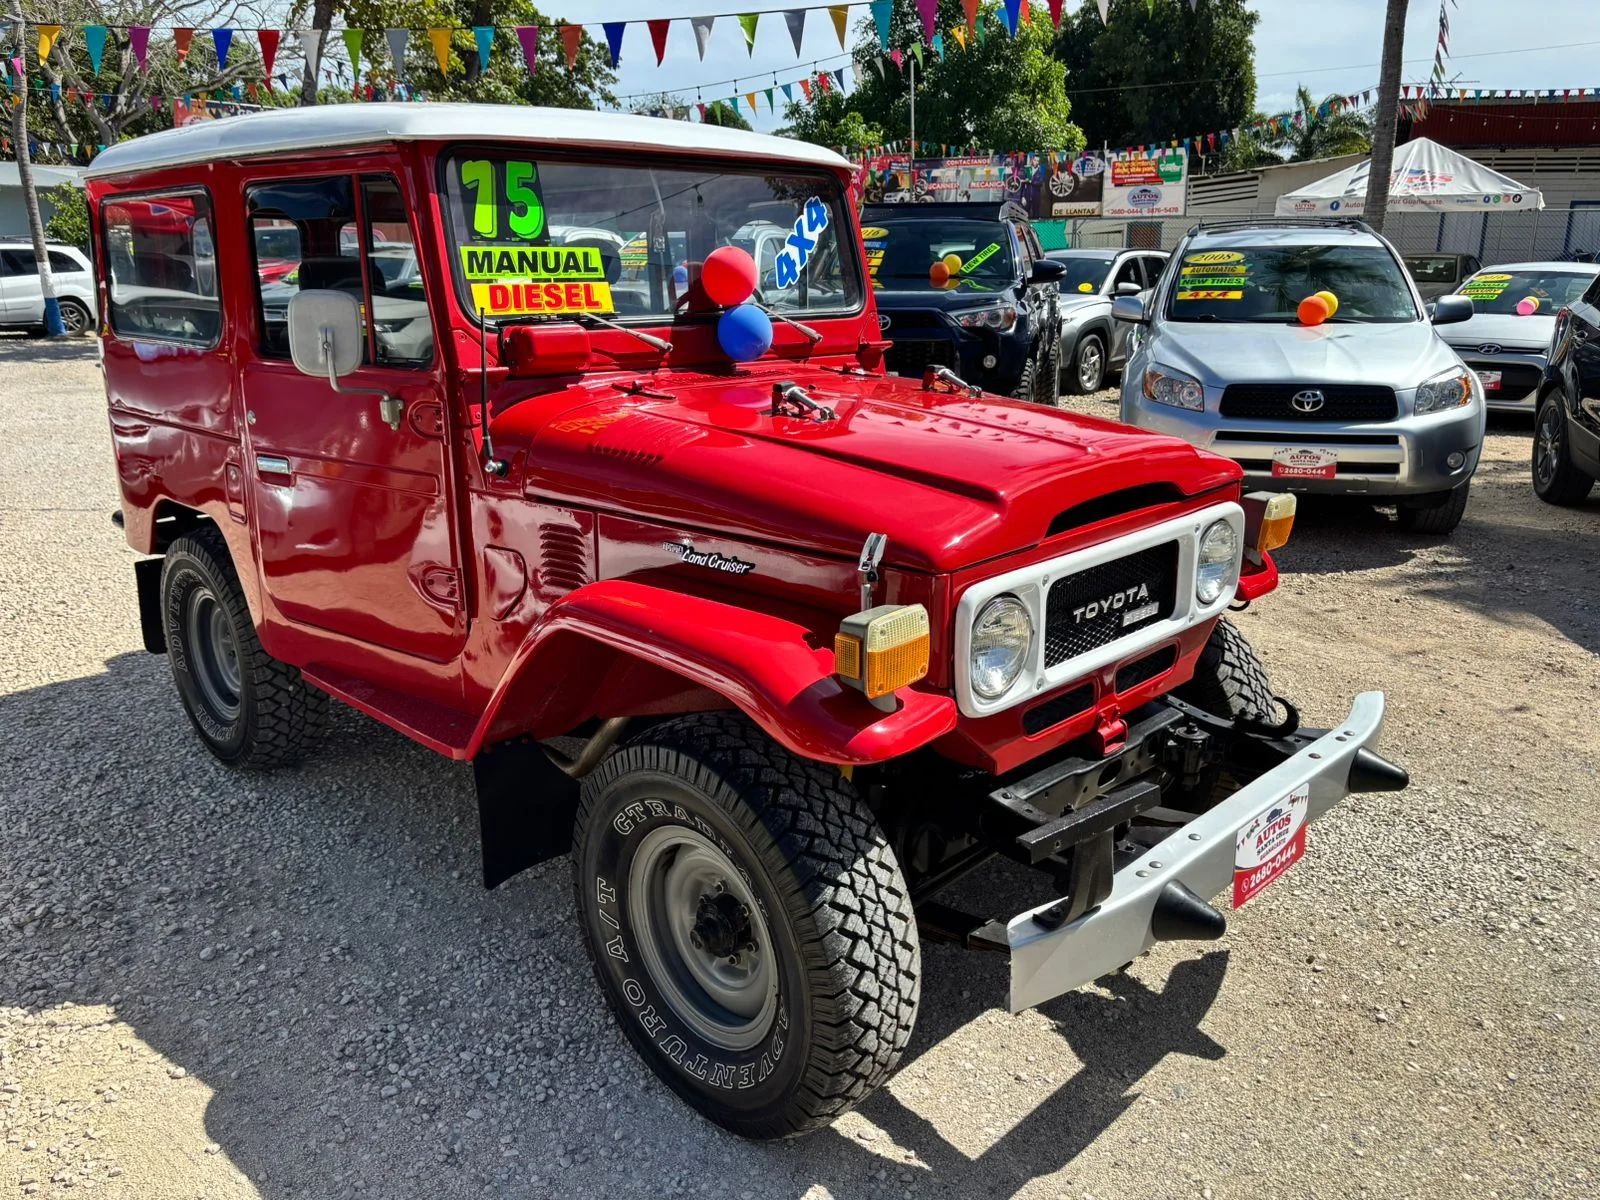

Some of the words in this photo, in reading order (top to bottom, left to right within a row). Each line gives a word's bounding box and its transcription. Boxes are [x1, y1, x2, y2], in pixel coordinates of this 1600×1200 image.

[775, 196, 828, 289] 4X4
[467, 250, 600, 276] MANUAL
[963, 257, 980, 271] NEW
[979, 244, 998, 260] TIRES
[1193, 253, 1234, 262] 2008
[1182, 278, 1207, 286] NEW
[489, 283, 603, 312] DIESEL
[1284, 467, 1327, 475] 2680-0444
[682, 549, 708, 566] Land
[708, 555, 750, 574] Cruiser
[1072, 583, 1149, 623] TOYOTA
[1256, 813, 1291, 849] AUTOS
[1249, 842, 1297, 889] 2680-0444
[596, 877, 630, 963] A/T
